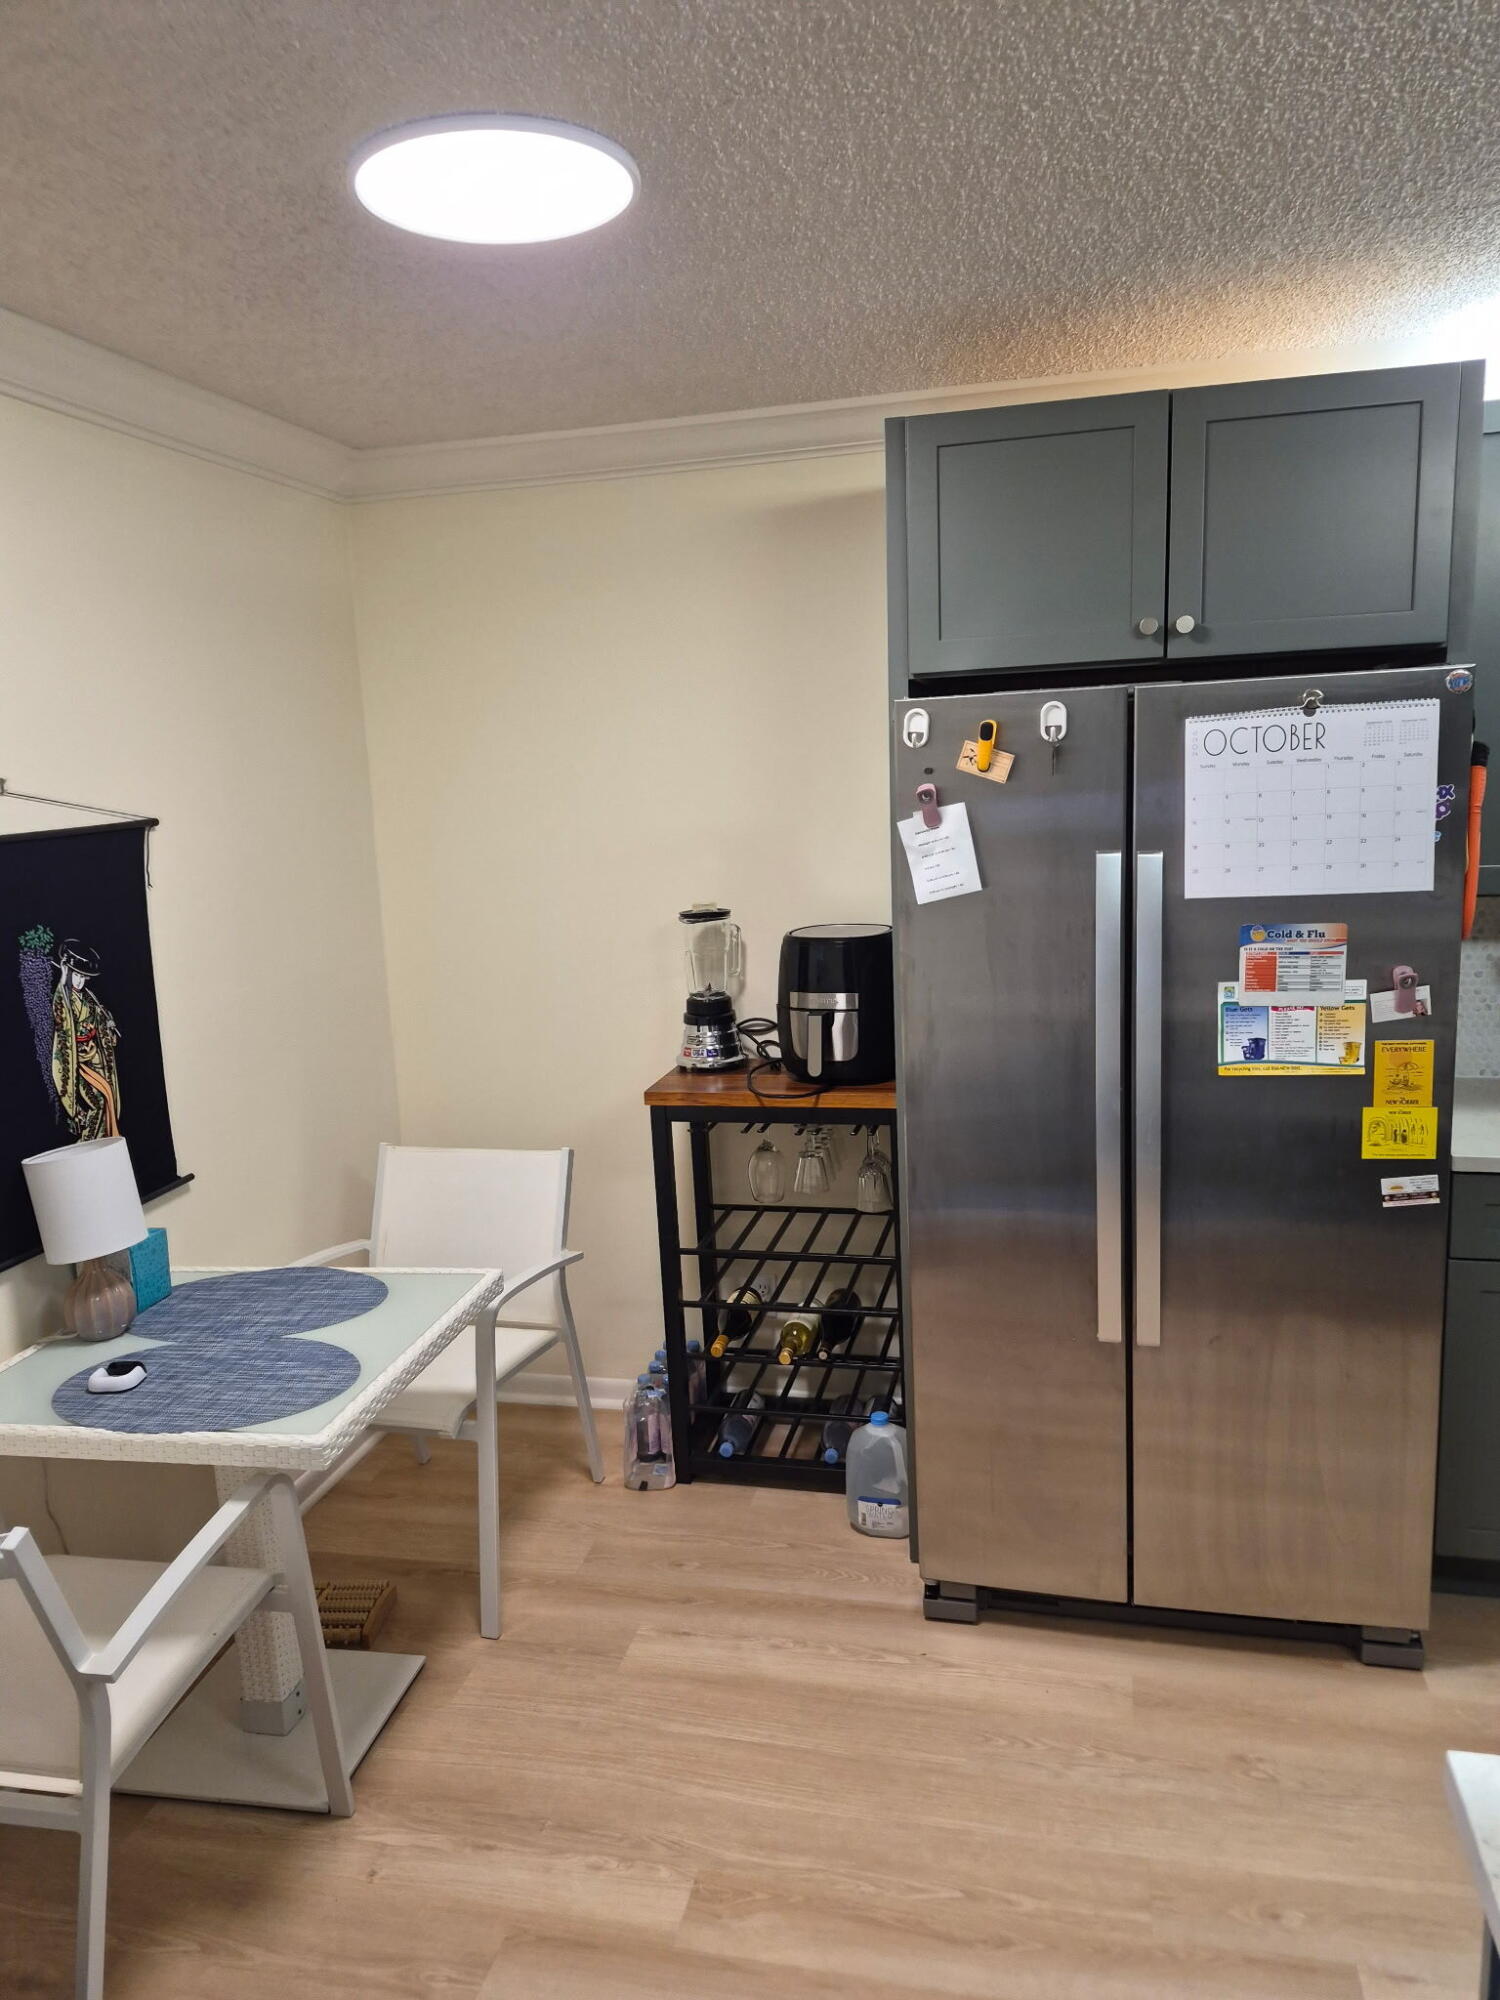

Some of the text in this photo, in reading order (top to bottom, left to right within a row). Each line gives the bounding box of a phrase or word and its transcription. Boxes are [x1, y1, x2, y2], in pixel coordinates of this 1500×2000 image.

[1203, 722, 1326, 757] OCTOBER
[1267, 929, 1292, 938] Cold
[1295, 930, 1304, 938] &
[1307, 930, 1326, 938] Flu
[692, 1049, 705, 1057] USA
